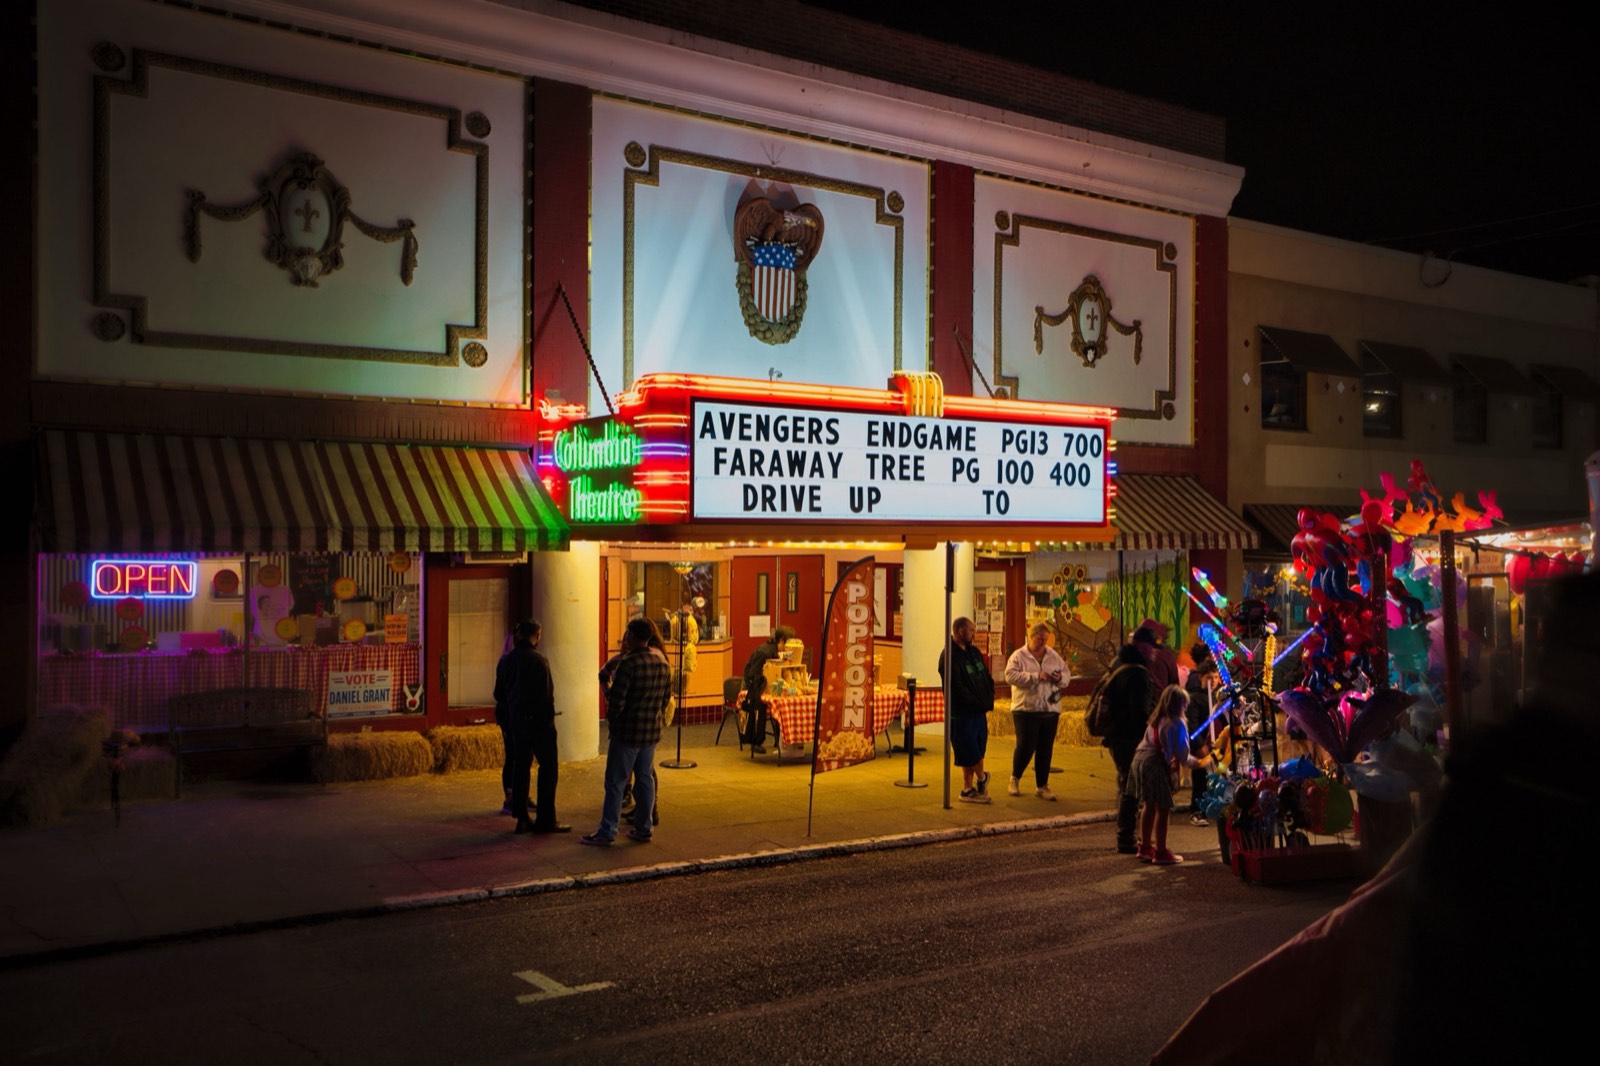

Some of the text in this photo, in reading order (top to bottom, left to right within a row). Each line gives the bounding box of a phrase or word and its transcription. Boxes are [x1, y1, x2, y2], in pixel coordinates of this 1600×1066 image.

[554, 422, 638, 471] Columbia
[699, 410, 1105, 459] AVENGERS ENDGAME PG13 700
[713, 446, 1091, 487] FARAWAY TREE PG 100 400
[569, 475, 638, 520] Theatre
[742, 483, 1010, 516] DRIVE UP TO
[95, 563, 193, 595] OPEN
[842, 581, 868, 730] POPCORN
[329, 688, 390, 705] DANIEL GRANT
[345, 673, 376, 686] VOTE
